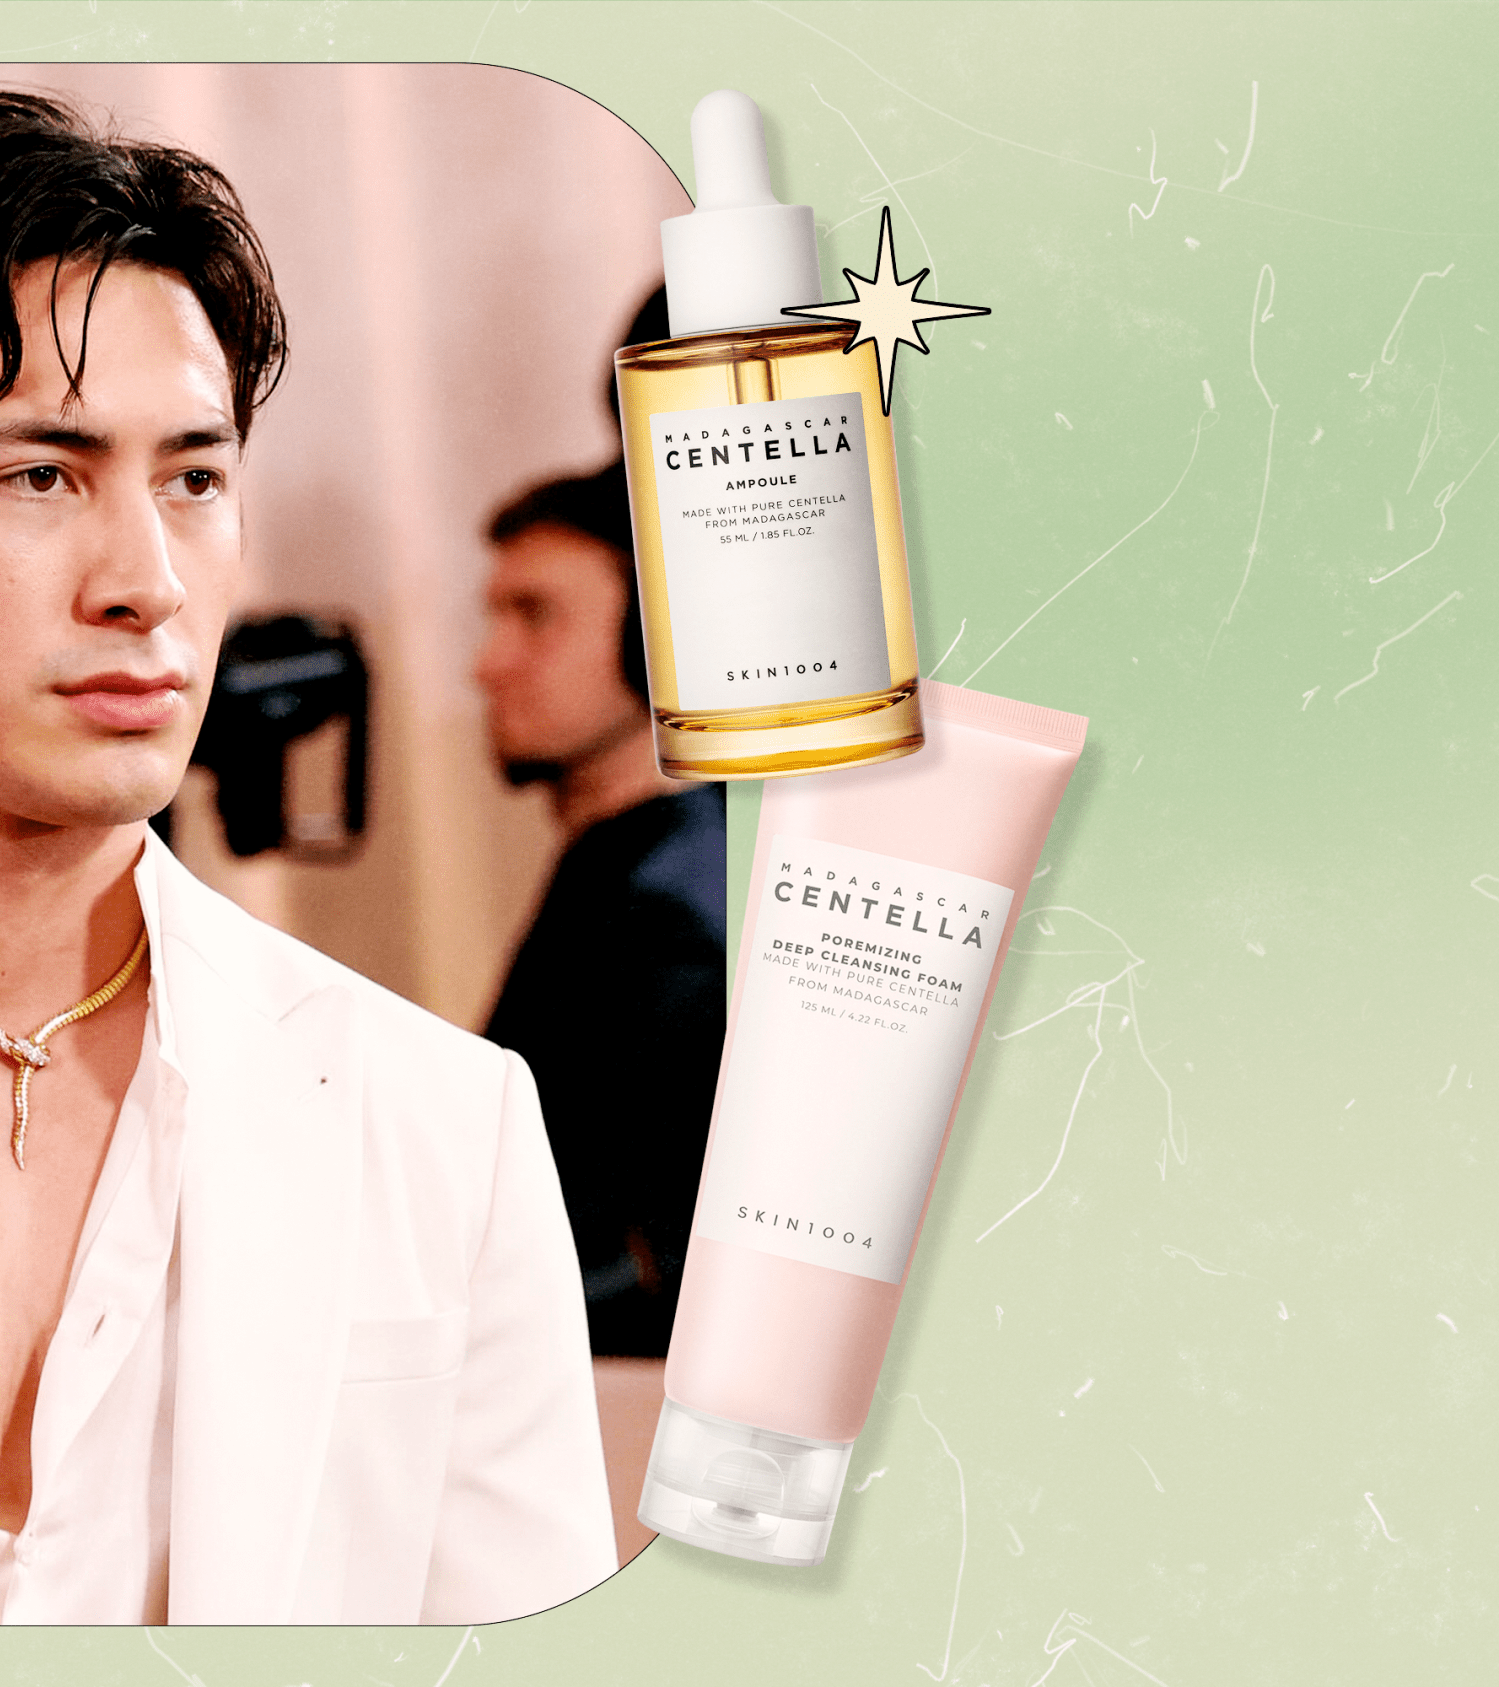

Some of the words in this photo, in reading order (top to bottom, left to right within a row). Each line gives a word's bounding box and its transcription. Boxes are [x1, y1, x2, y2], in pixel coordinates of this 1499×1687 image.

[666, 416, 847, 443] MADAGASCAR
[666, 432, 851, 470] CENTELLA
[726, 475, 797, 490] AMPOULE
[683, 508, 711, 518] MADE
[717, 505, 747, 515] WITH
[752, 501, 782, 512] PURE
[789, 494, 846, 508] CENTELLA
[706, 519, 737, 528] FROM
[742, 509, 825, 525] MADAGASCAR
[720, 535, 731, 544] 55
[735, 533, 749, 542] ML
[761, 530, 779, 540] 1.85
[783, 527, 814, 538] FL.OZ.
[781, 863, 990, 920] MADAGASCAR
[774, 881, 982, 949] CENTELLA
[821, 933, 922, 964] POREMIZING
[763, 952, 799, 968] MADE
[806, 962, 841, 978] WITH
[847, 971, 883, 988] PURE
[890, 982, 959, 1008] CENTELLA
[773, 939, 814, 956] DEEP
[821, 951, 911, 979] CLEANSING
[918, 973, 963, 992] FOAM
[789, 976, 828, 992] FROM
[833, 986, 928, 1016] MADAGASCAR
[801, 1000, 817, 1012] 125
[821, 1005, 836, 1017] ML
[848, 1012, 870, 1025] 4.22
[874, 1018, 907, 1033] FL.OZ.
